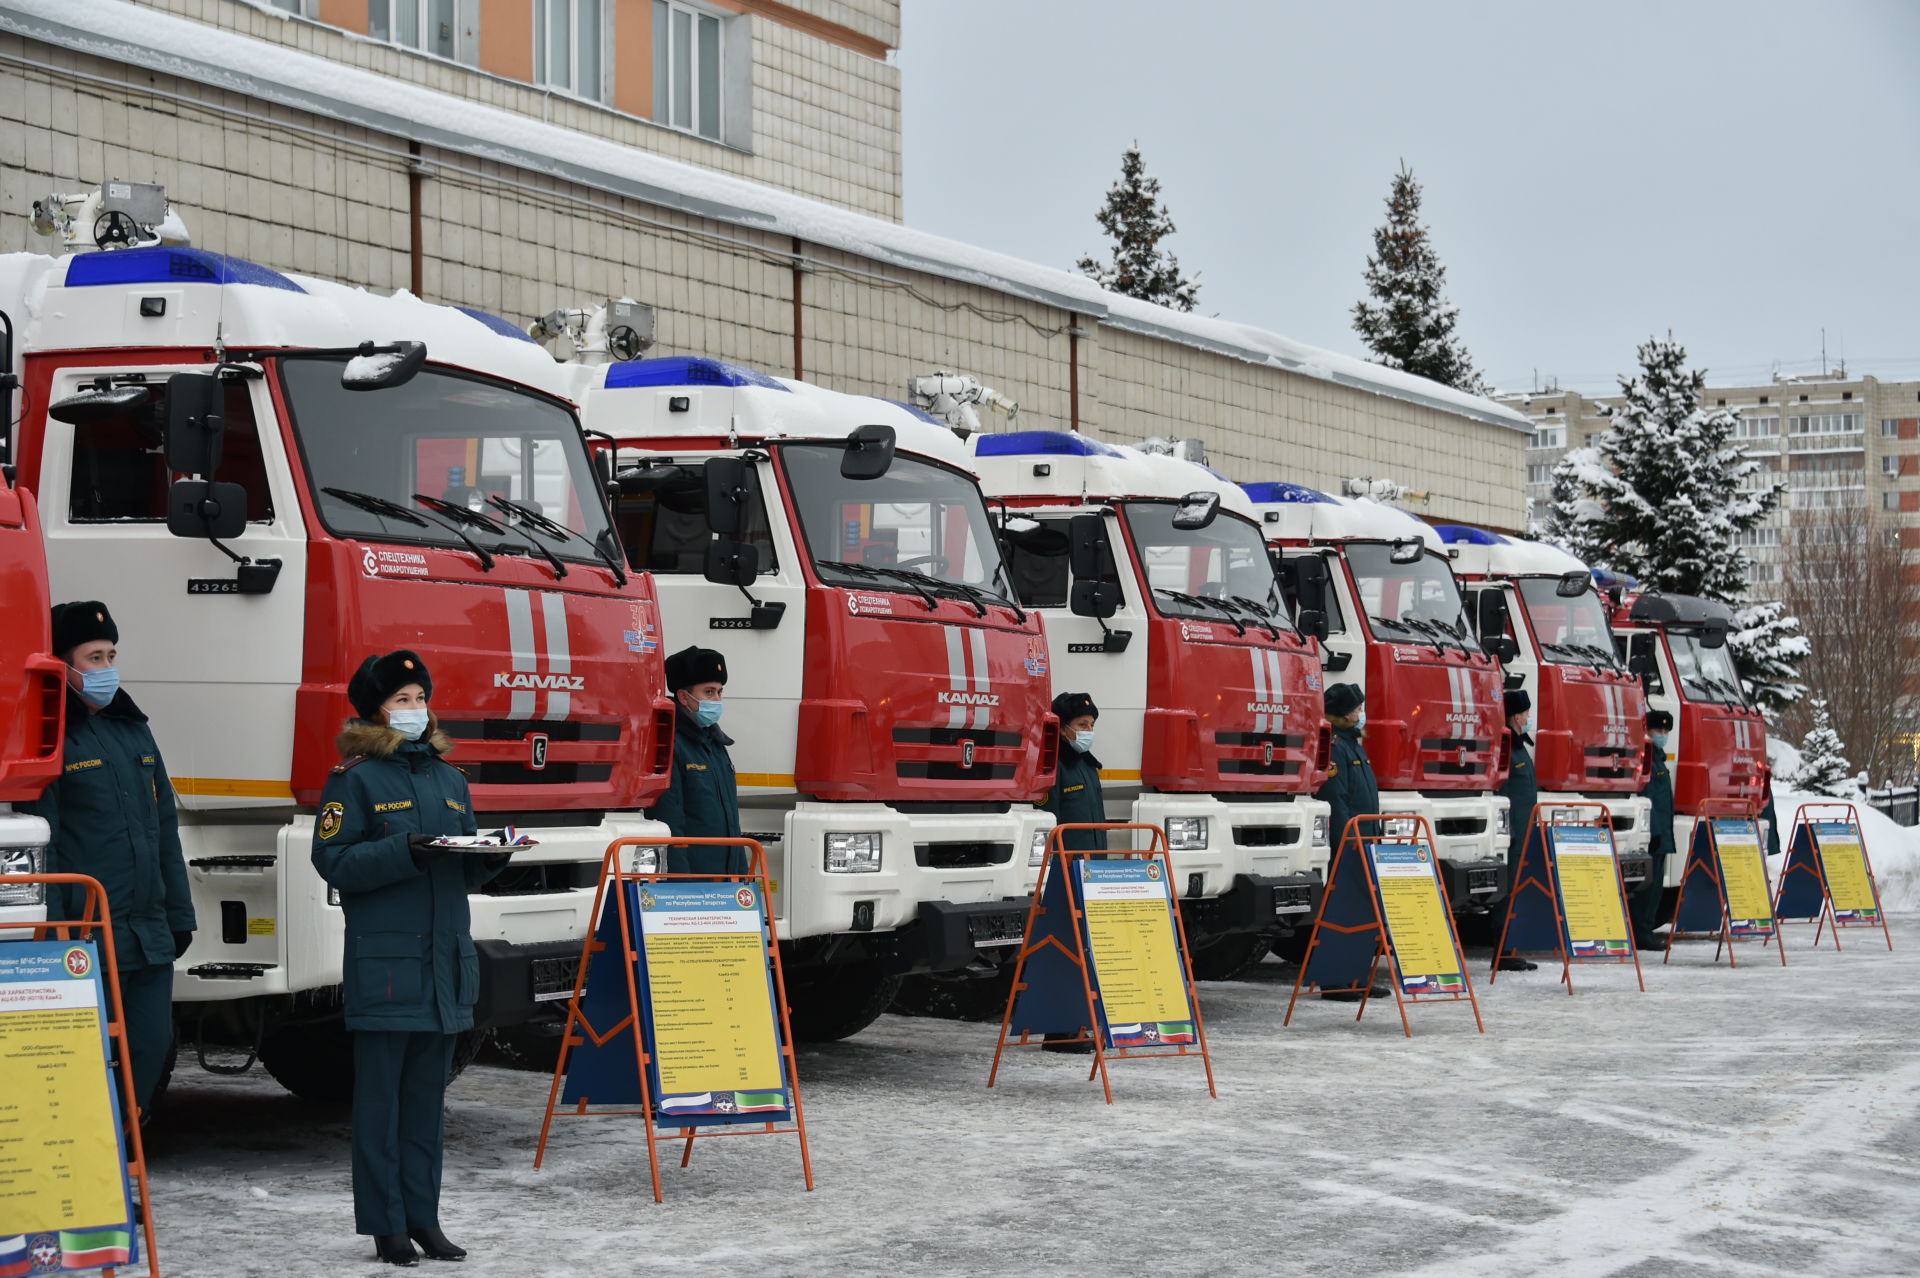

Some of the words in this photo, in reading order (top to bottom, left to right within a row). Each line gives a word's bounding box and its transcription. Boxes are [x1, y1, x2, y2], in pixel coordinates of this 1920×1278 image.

[378, 551, 427, 565] СПЕЦТЕХНИКА
[380, 564, 429, 576] ПОЖАРОТУШЕНИЯ
[191, 583, 238, 592] 43265
[857, 595, 891, 606] СПЕЦТЕХНИКА
[712, 620, 752, 628] 43265
[493, 673, 585, 690] KAMAZ
[937, 691, 1000, 706] KAMAZ
[1247, 702, 1290, 714] KAMAZ
[1446, 713, 1480, 723] KAMAZ
[80, 758, 102, 768] РОССИИ
[374, 803, 387, 812] МЧС
[388, 799, 412, 810] РОССИИ
[19, 957, 37, 965] МЧС
